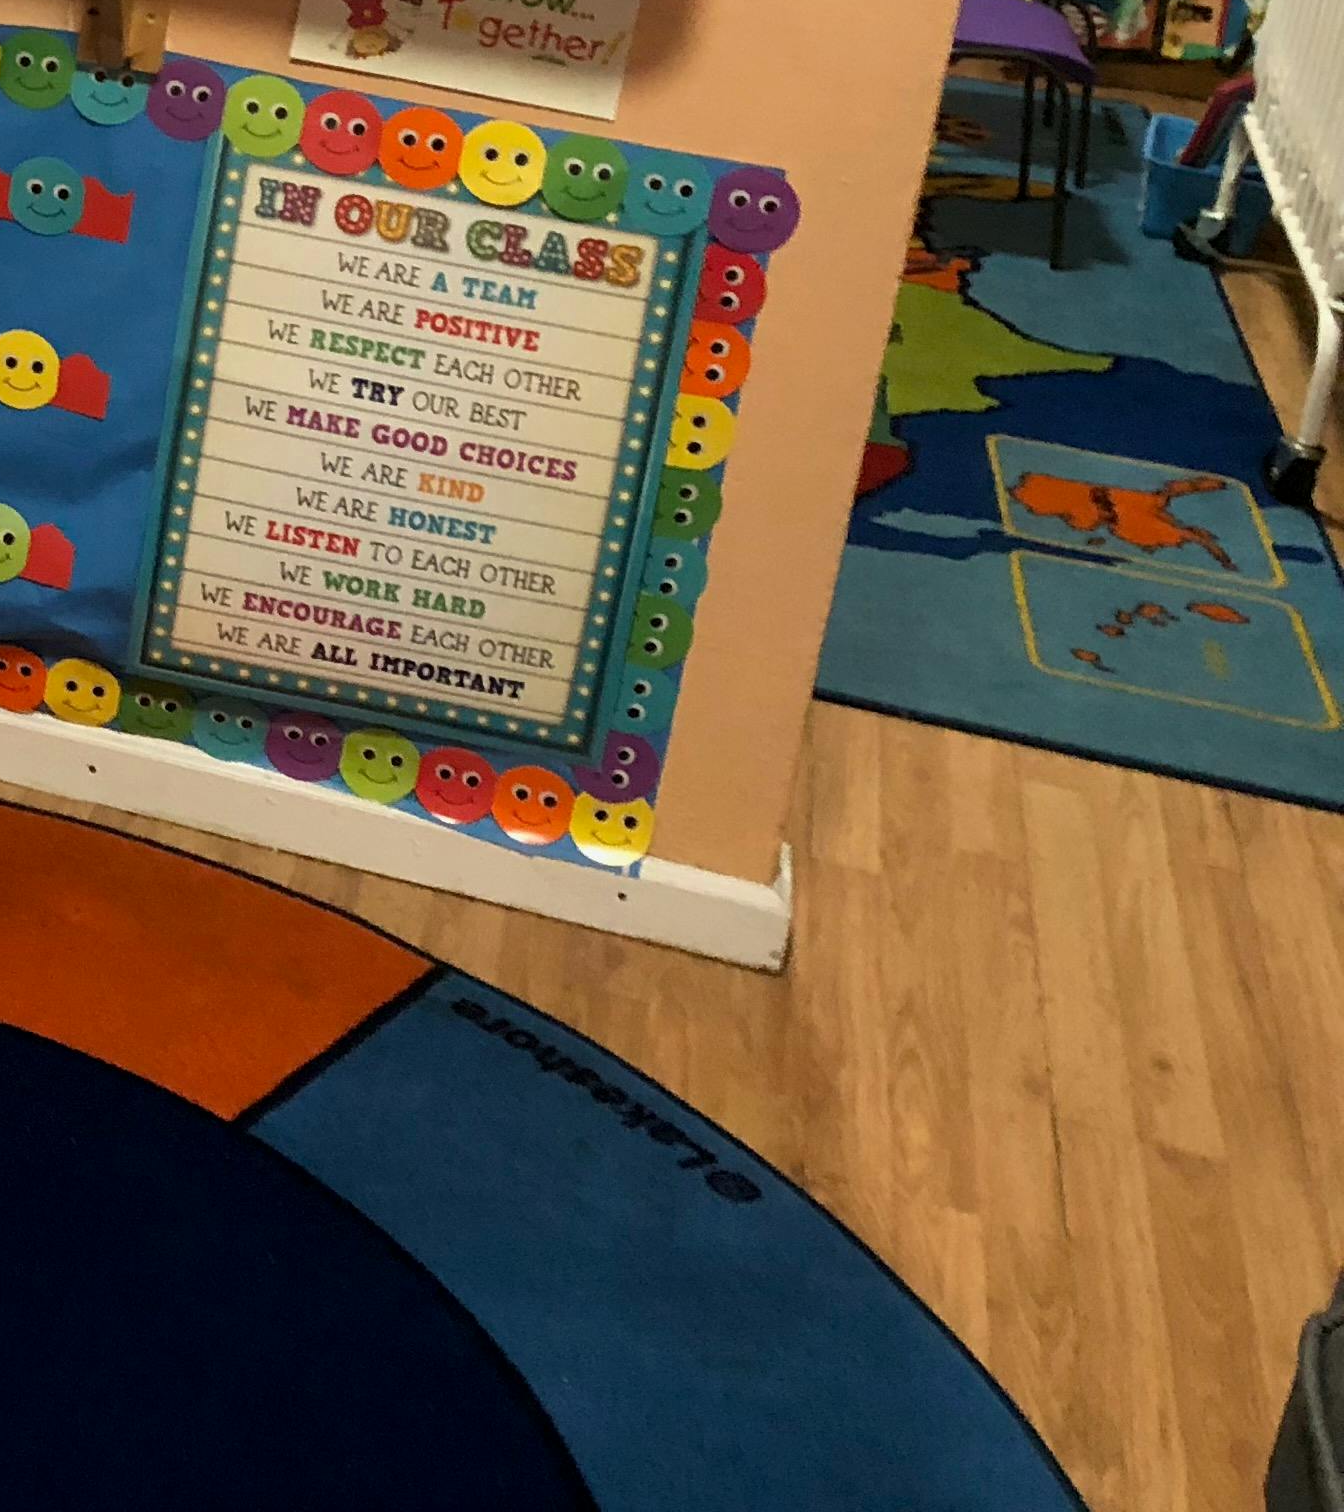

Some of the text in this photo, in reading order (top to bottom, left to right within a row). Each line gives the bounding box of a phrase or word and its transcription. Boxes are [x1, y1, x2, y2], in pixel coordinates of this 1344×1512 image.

[256, 177, 646, 288] IN OUR CLASS
[338, 252, 538, 310] WE ARE A TEAM
[321, 290, 541, 352] WE ARE POSITIVE
[268, 319, 583, 402] WE RESPECT EACH OTHER
[308, 368, 527, 432] WE TRY OUR BEST
[246, 396, 578, 482] WE MAKE GOOD CHOICES
[320, 452, 486, 504] WE ARE KIND
[296, 487, 497, 545] WE ARE HONEST
[225, 511, 556, 595] WE LISTEN TO EACH OTHER
[280, 561, 487, 619] WE WORK HARD
[201, 583, 556, 670] WE ENCOURAGE EACH OTHER
[217, 622, 526, 700] WE ARE ALL IMPORTANT
